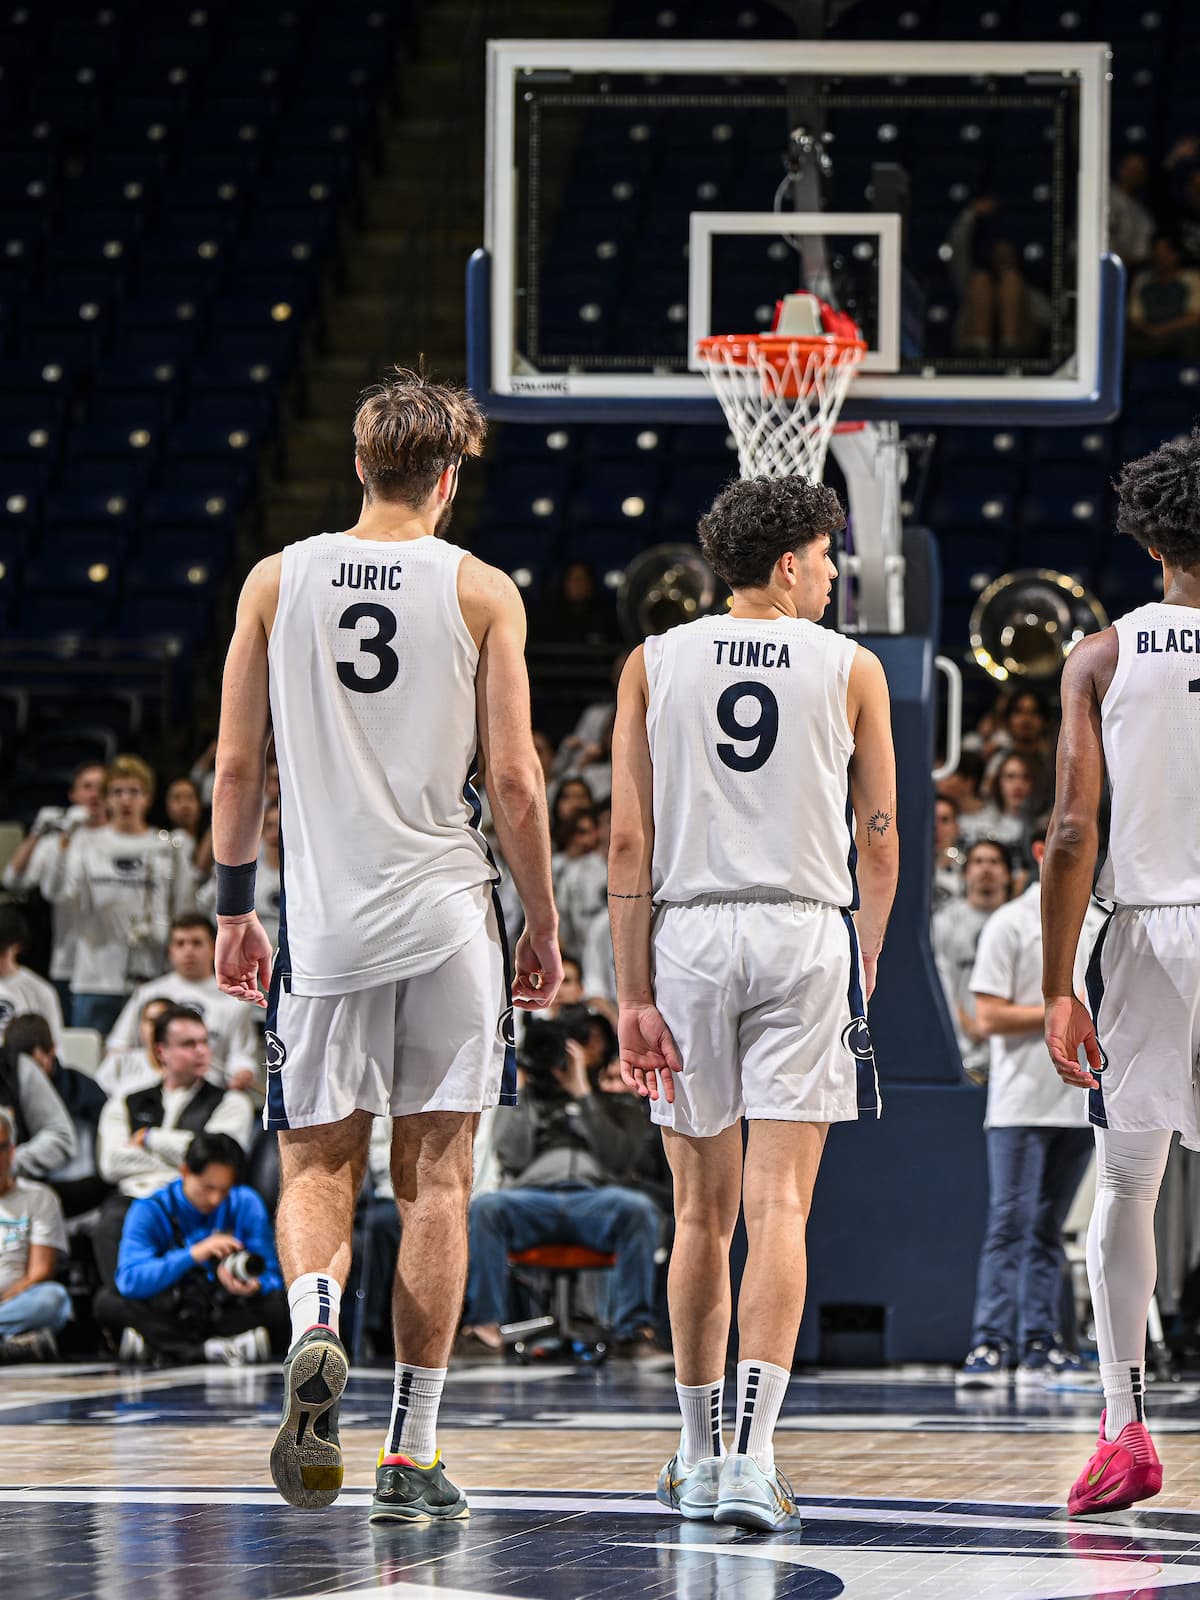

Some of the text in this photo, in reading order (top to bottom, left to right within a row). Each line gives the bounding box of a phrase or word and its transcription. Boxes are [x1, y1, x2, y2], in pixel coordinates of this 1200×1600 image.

[331, 560, 402, 591] JURIĆ
[336, 602, 399, 693] 3
[714, 641, 791, 668] TUNCA
[717, 681, 779, 772] 9
